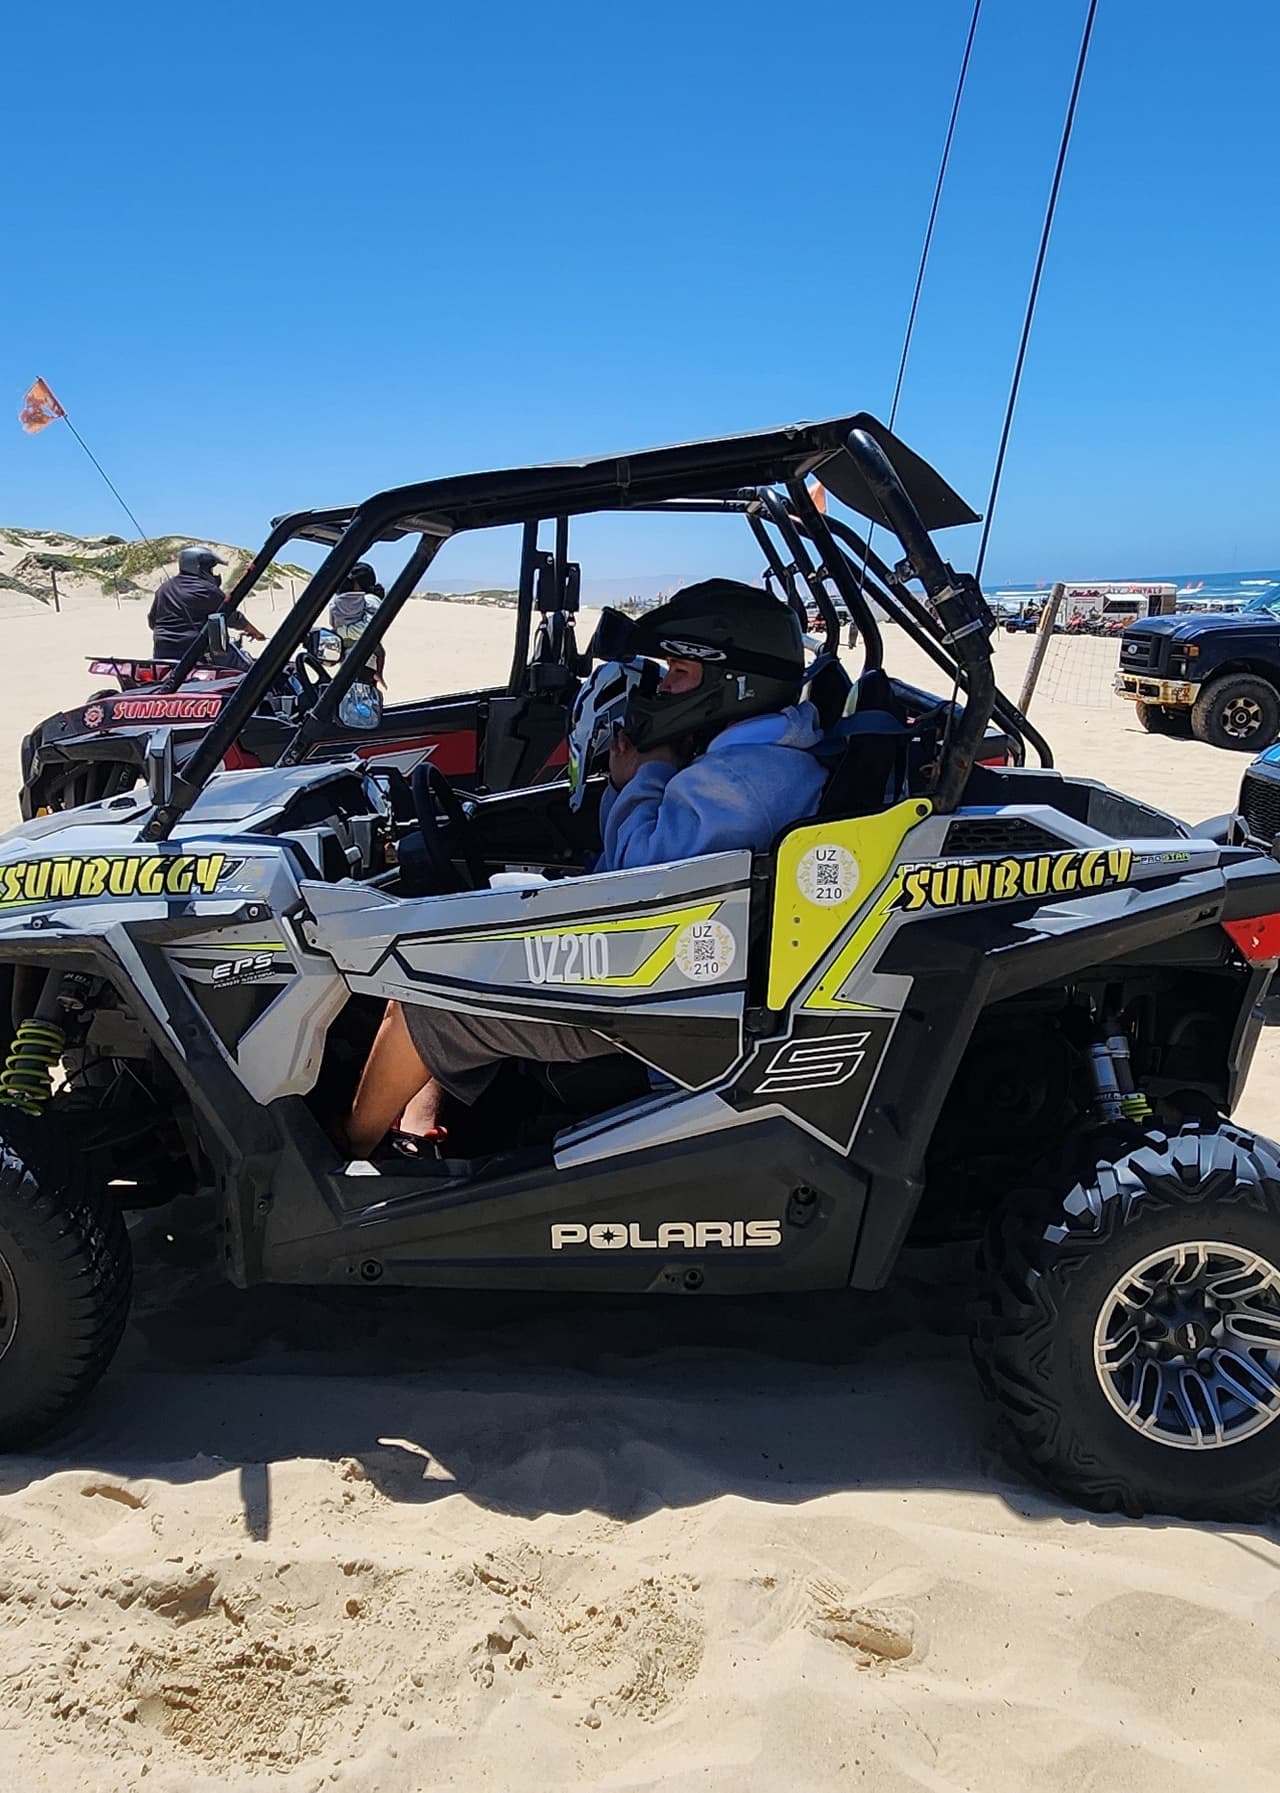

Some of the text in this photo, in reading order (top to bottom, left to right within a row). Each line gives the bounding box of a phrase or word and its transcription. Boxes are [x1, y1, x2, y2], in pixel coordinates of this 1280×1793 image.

[112, 699, 223, 720] SUNBUGGY
[815, 849, 837, 862] UZ
[0, 853, 226, 902] SUNBUGGY
[904, 847, 1132, 909] SUNBUGGY
[815, 887, 843, 900] 210
[691, 925, 714, 939] UZ
[211, 951, 275, 980] EPS
[524, 932, 609, 985] UZ210
[693, 961, 719, 976] 210
[752, 1030, 873, 1094] S
[550, 1219, 782, 1250] POLARIS
